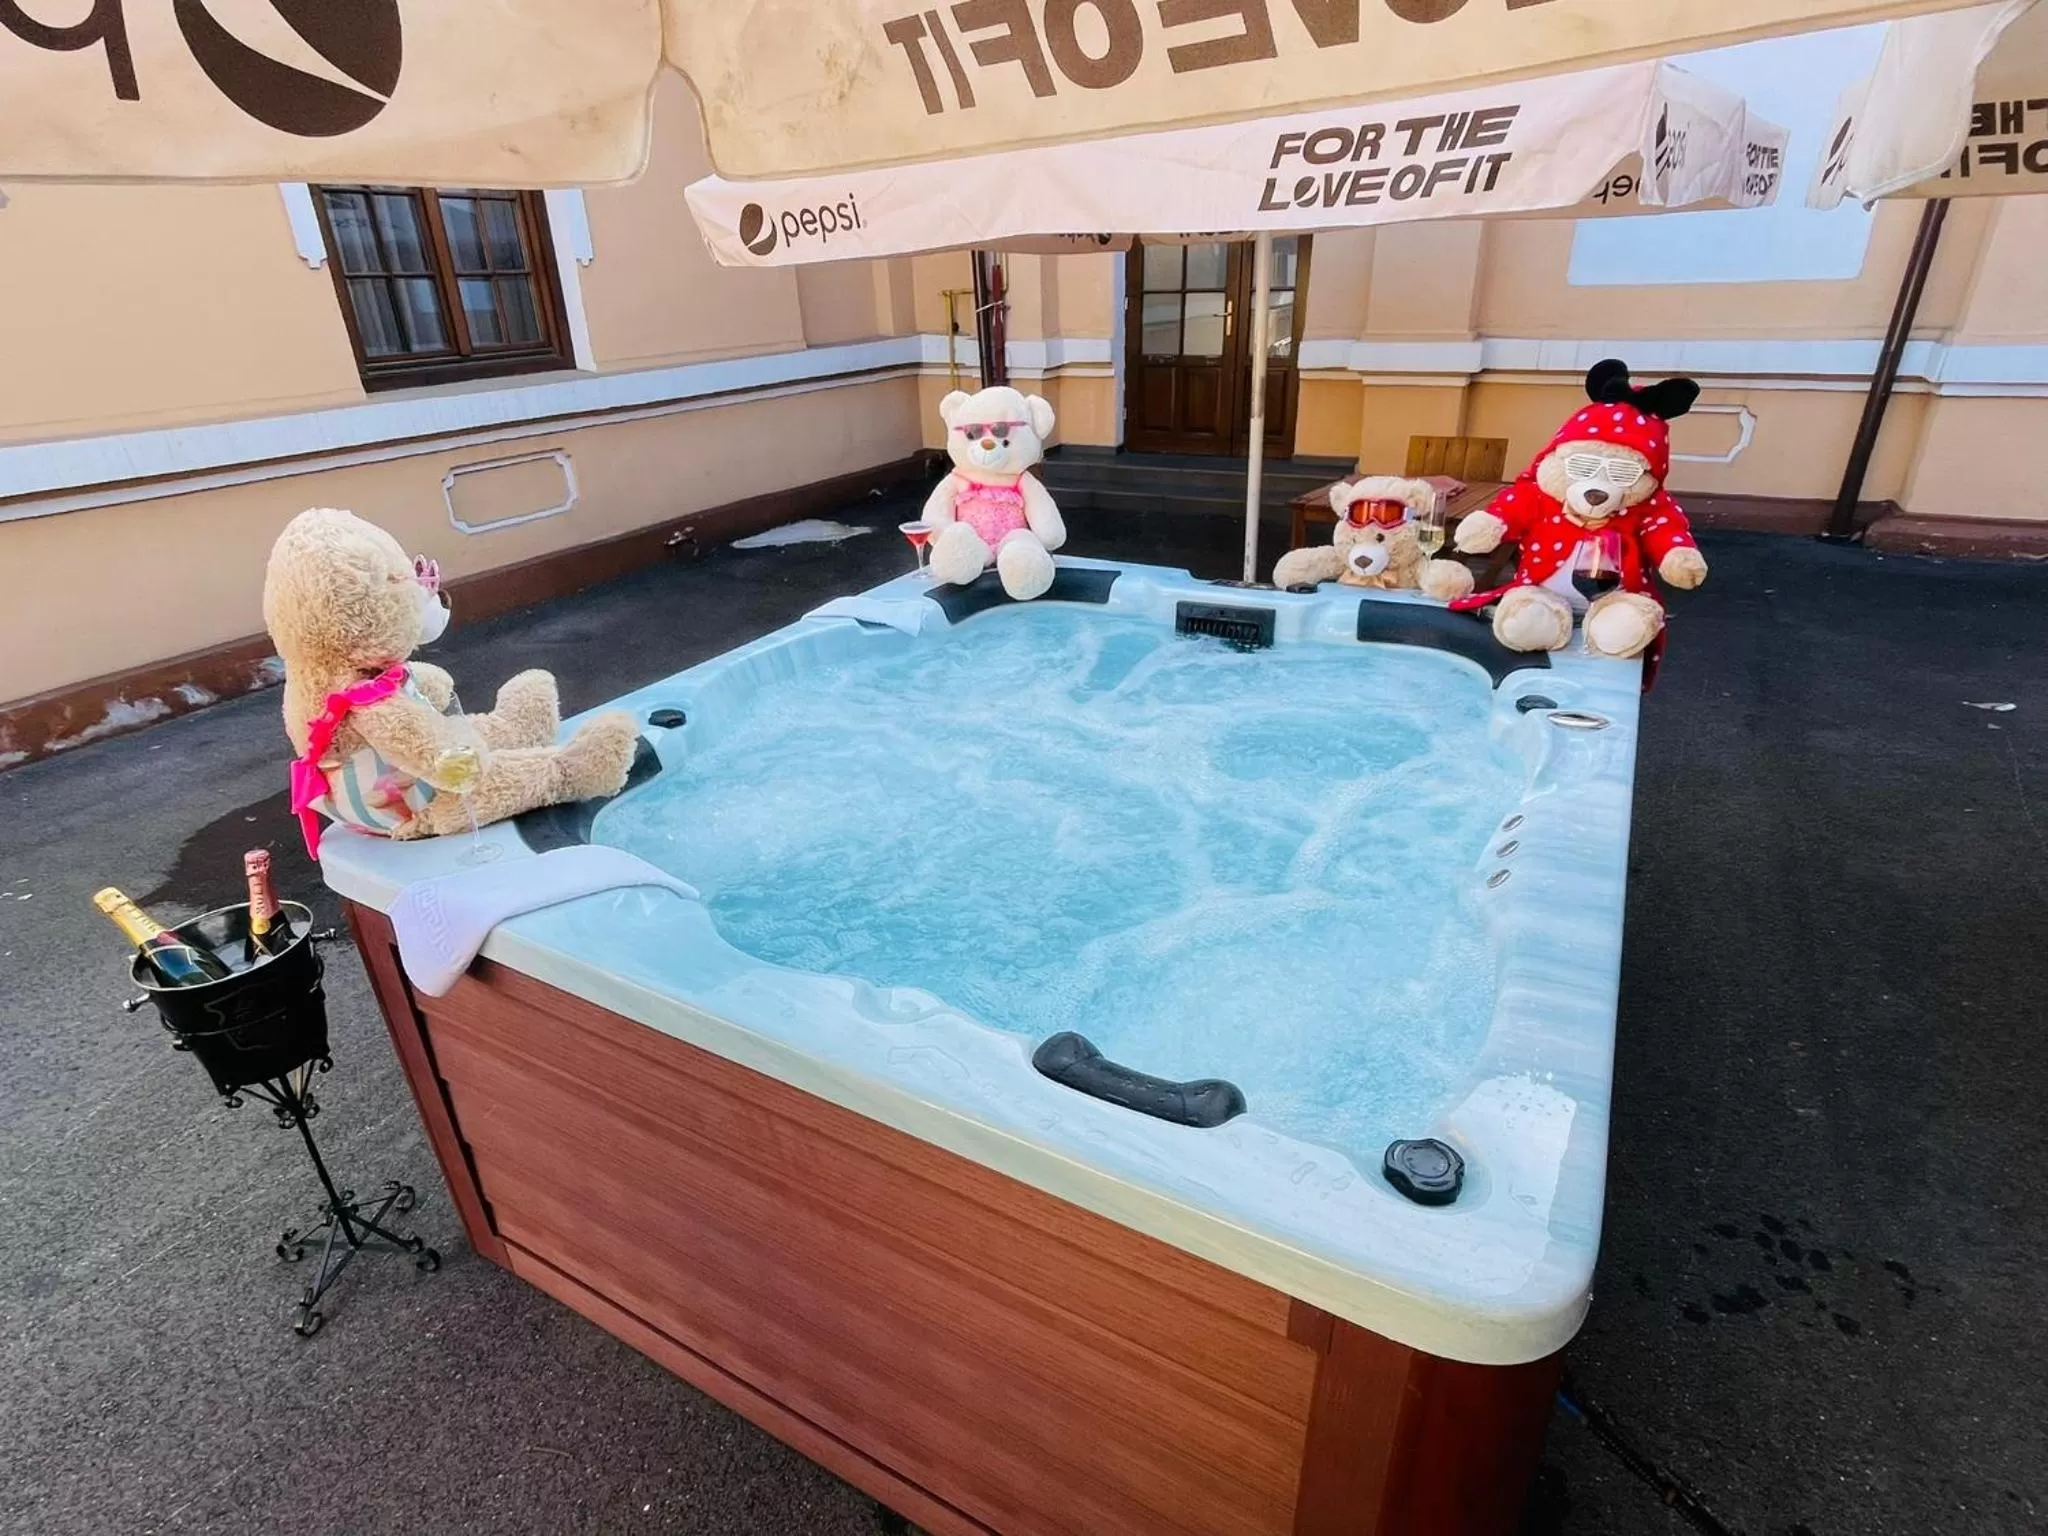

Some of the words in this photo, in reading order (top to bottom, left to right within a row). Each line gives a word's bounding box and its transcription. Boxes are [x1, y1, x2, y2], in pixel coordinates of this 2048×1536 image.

[1269, 123, 1387, 169] FOR
[1395, 105, 1521, 156] THE
[781, 192, 861, 247] pepsi
